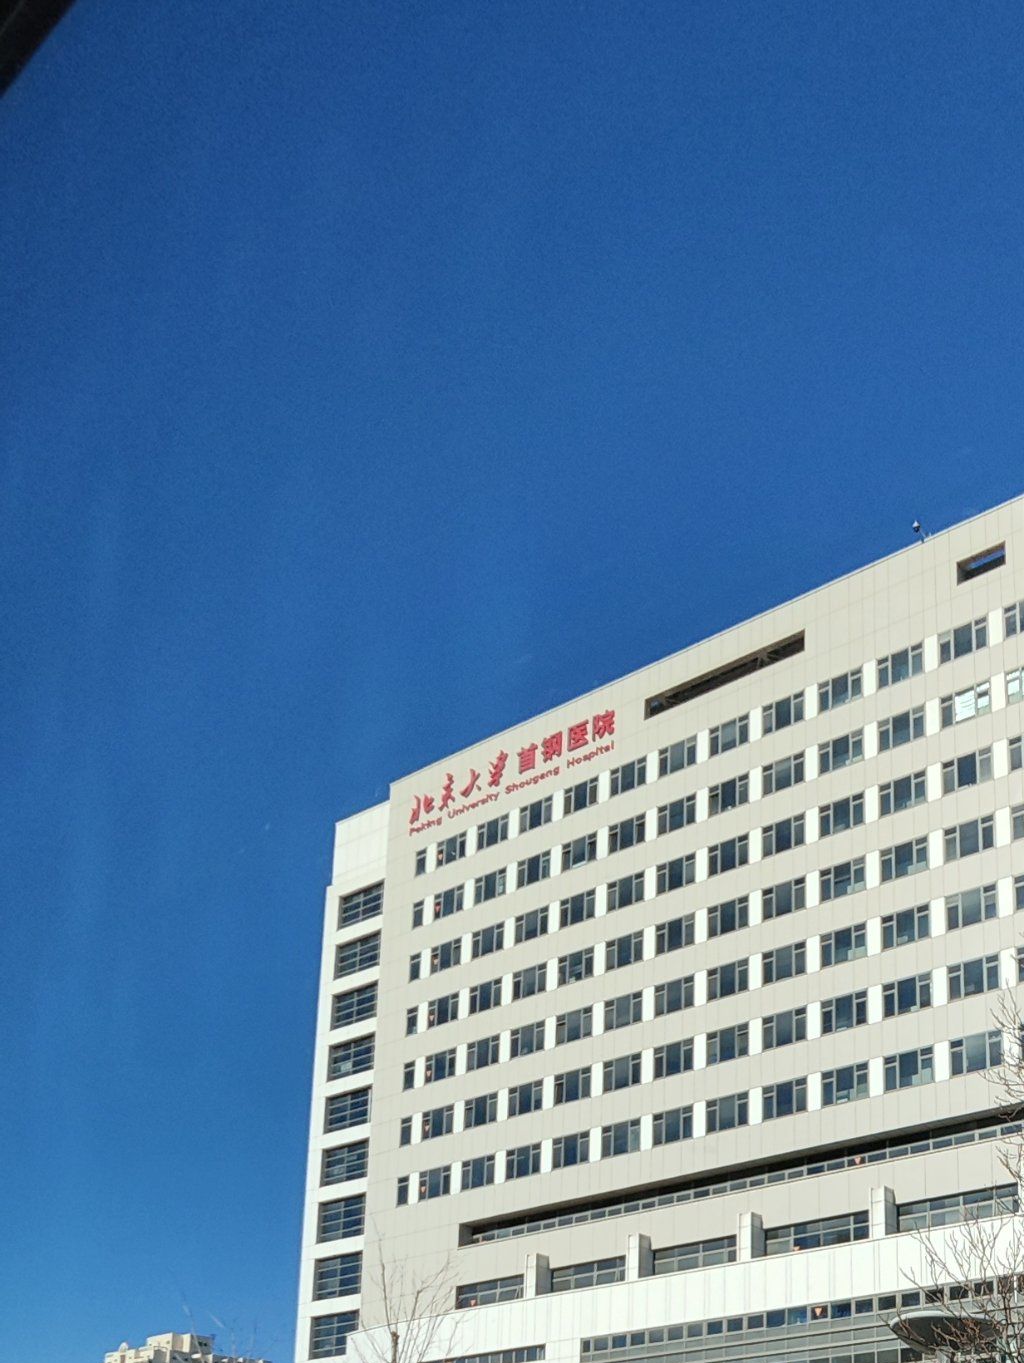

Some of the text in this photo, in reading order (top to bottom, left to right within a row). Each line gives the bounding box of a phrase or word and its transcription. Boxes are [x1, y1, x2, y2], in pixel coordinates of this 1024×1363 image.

[408, 740, 615, 837] Peking University Shougang Hospital
[409, 709, 616, 825] 北京大学首钢医院
